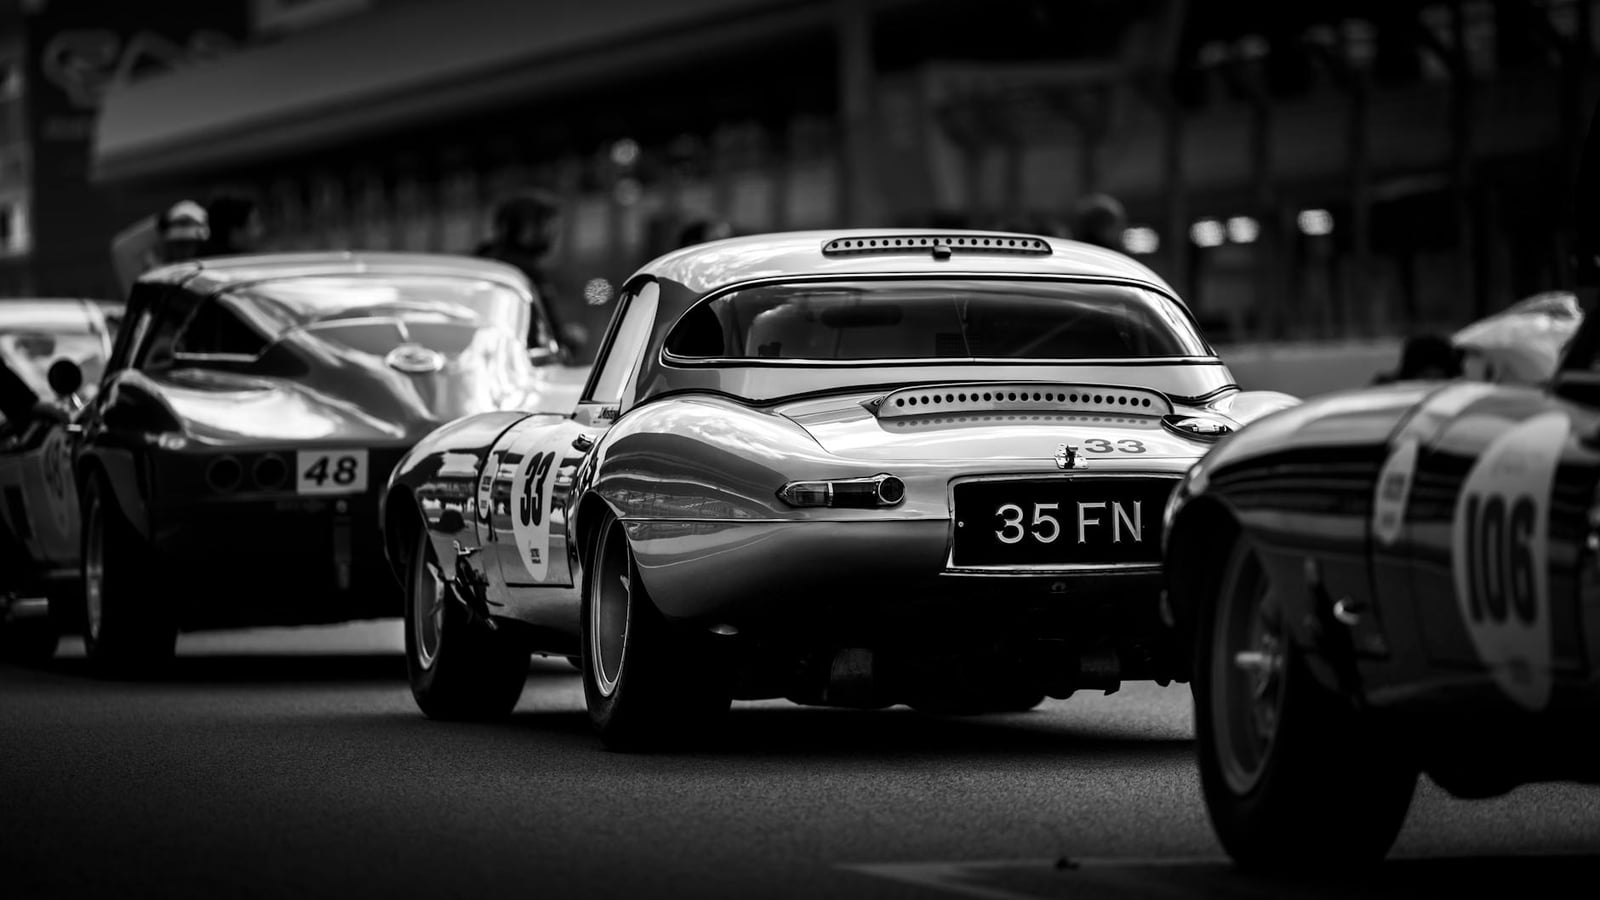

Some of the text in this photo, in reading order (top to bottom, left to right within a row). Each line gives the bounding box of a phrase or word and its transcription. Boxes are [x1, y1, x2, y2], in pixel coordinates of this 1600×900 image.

[1084, 438, 1147, 454] 33
[304, 456, 358, 486] 48
[520, 450, 556, 526] 33
[994, 499, 1143, 545] 35 FN
[1465, 493, 1537, 625] 106
